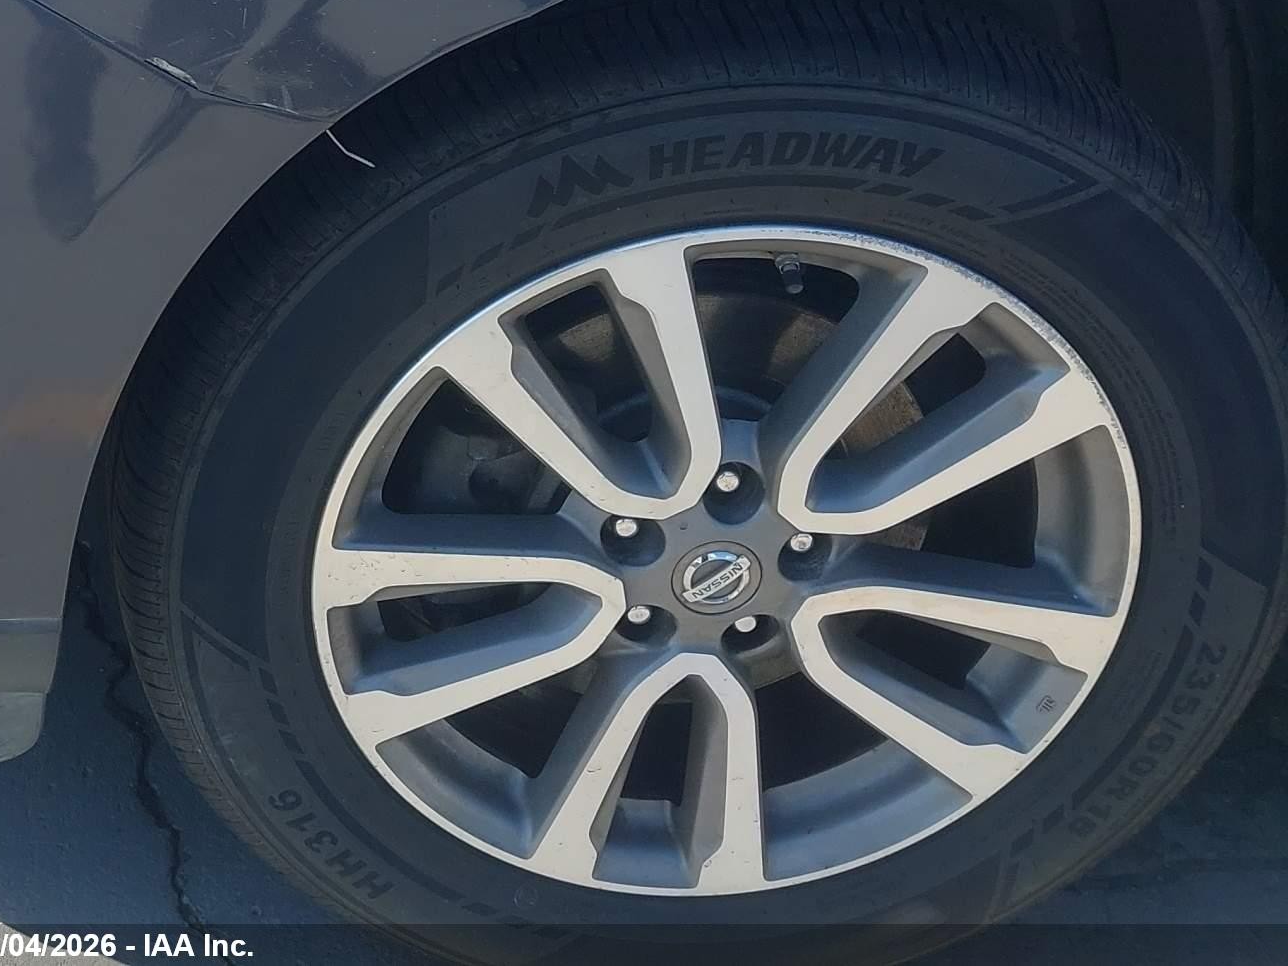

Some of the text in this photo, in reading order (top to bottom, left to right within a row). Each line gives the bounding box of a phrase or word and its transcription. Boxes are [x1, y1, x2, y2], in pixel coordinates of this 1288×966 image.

[649, 131, 945, 180] HEADWAY
[691, 562, 744, 600] NISSAN
[268, 789, 397, 900] HH316
